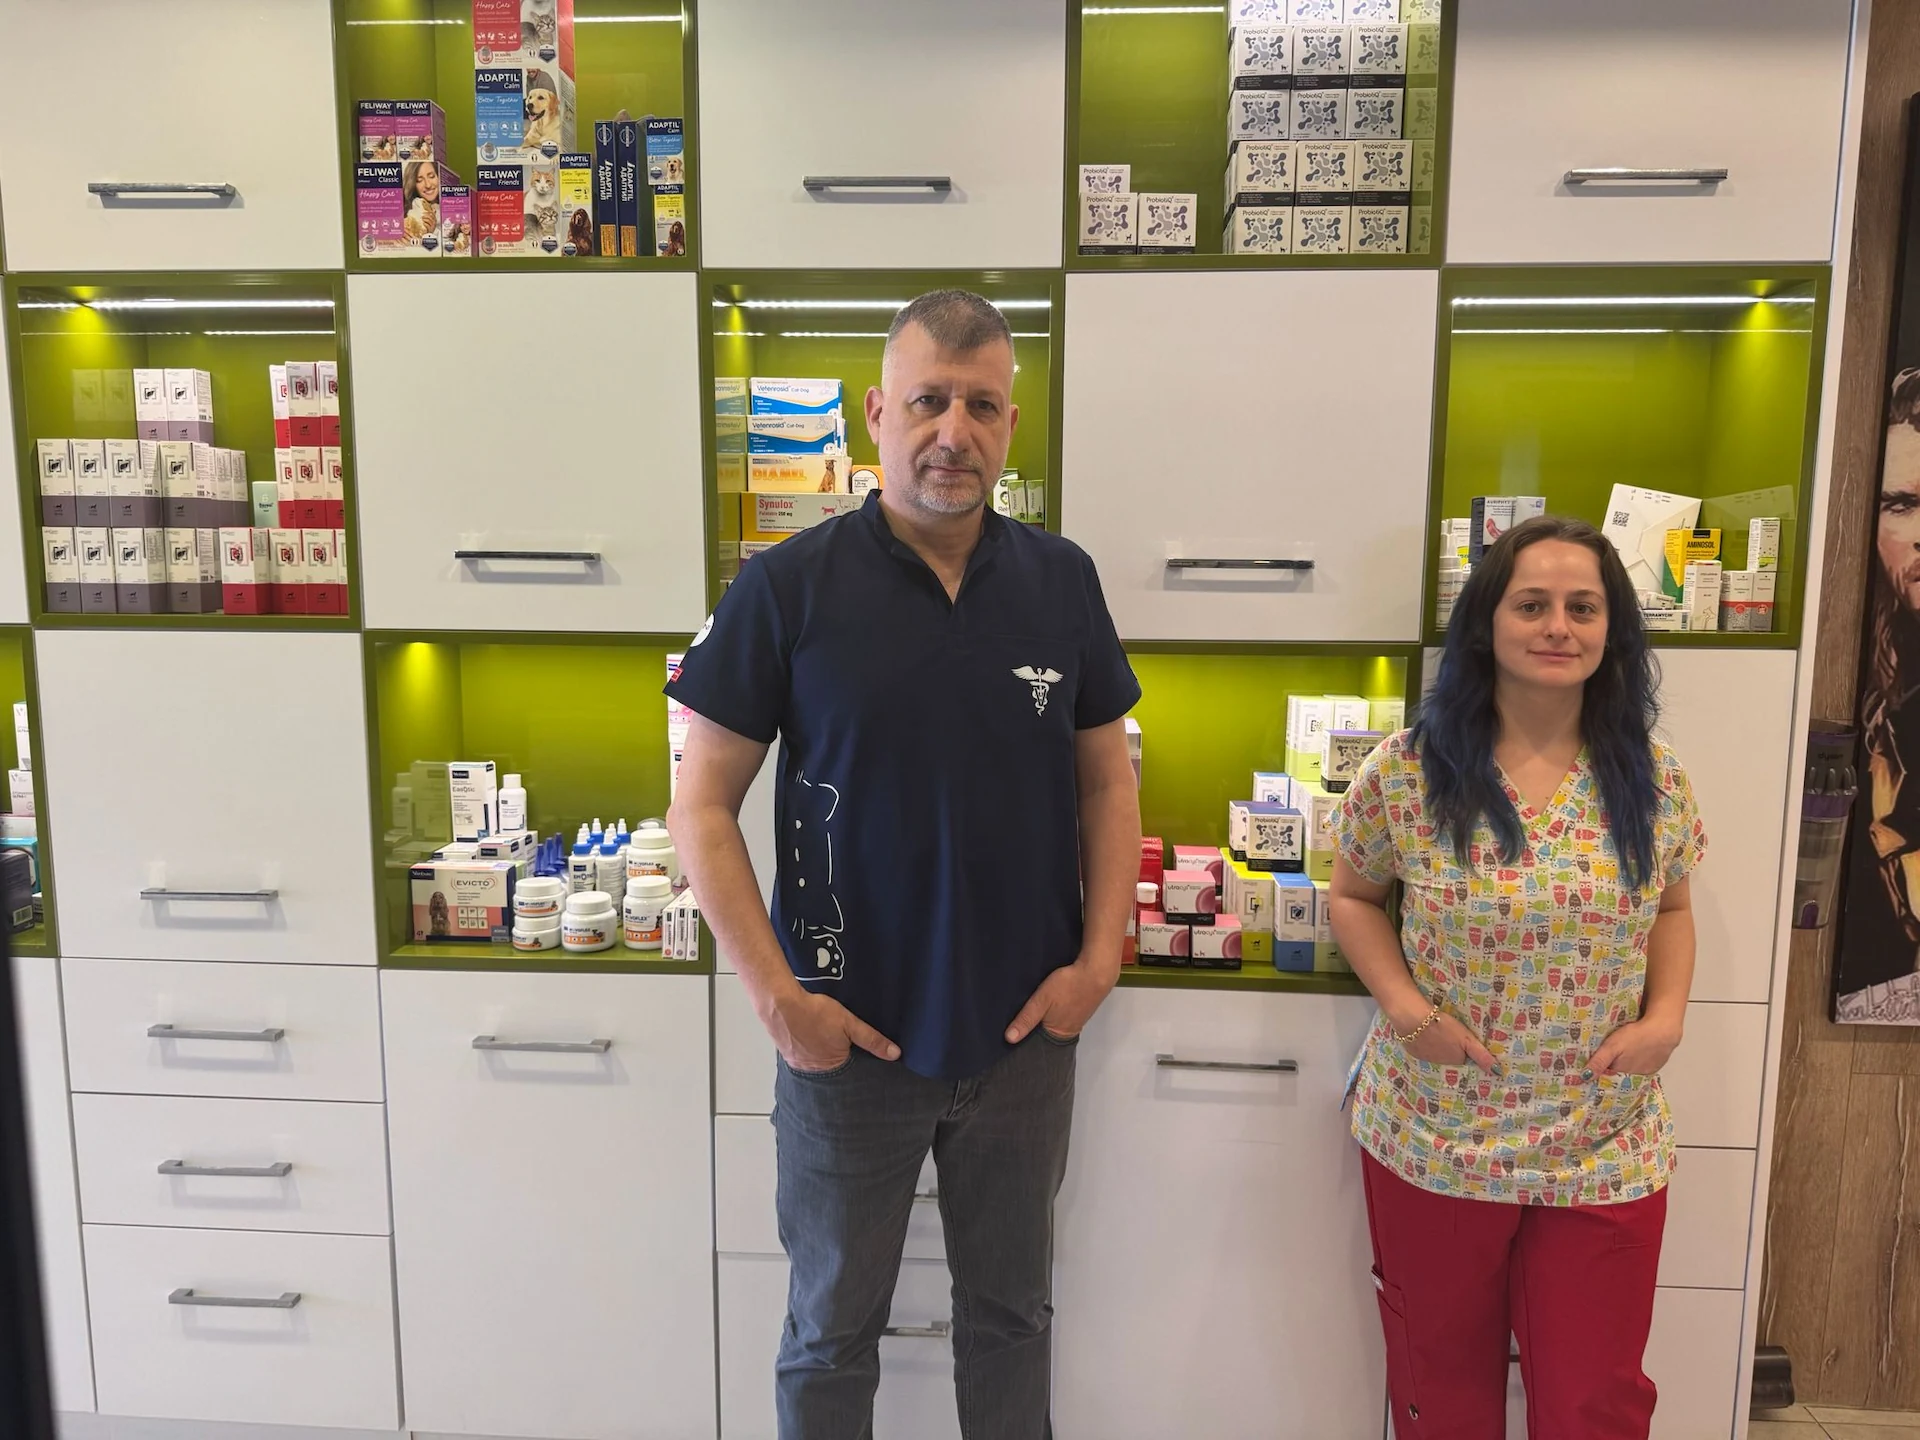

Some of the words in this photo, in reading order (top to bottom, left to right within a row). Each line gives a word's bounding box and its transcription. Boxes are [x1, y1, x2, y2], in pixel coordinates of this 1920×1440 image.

[478, 74, 520, 82] ADAPTIL
[358, 168, 399, 176] FELIWAY
[479, 171, 520, 179] FELIWAY
[359, 190, 379, 199] Happy
[759, 499, 793, 510] Synulox
